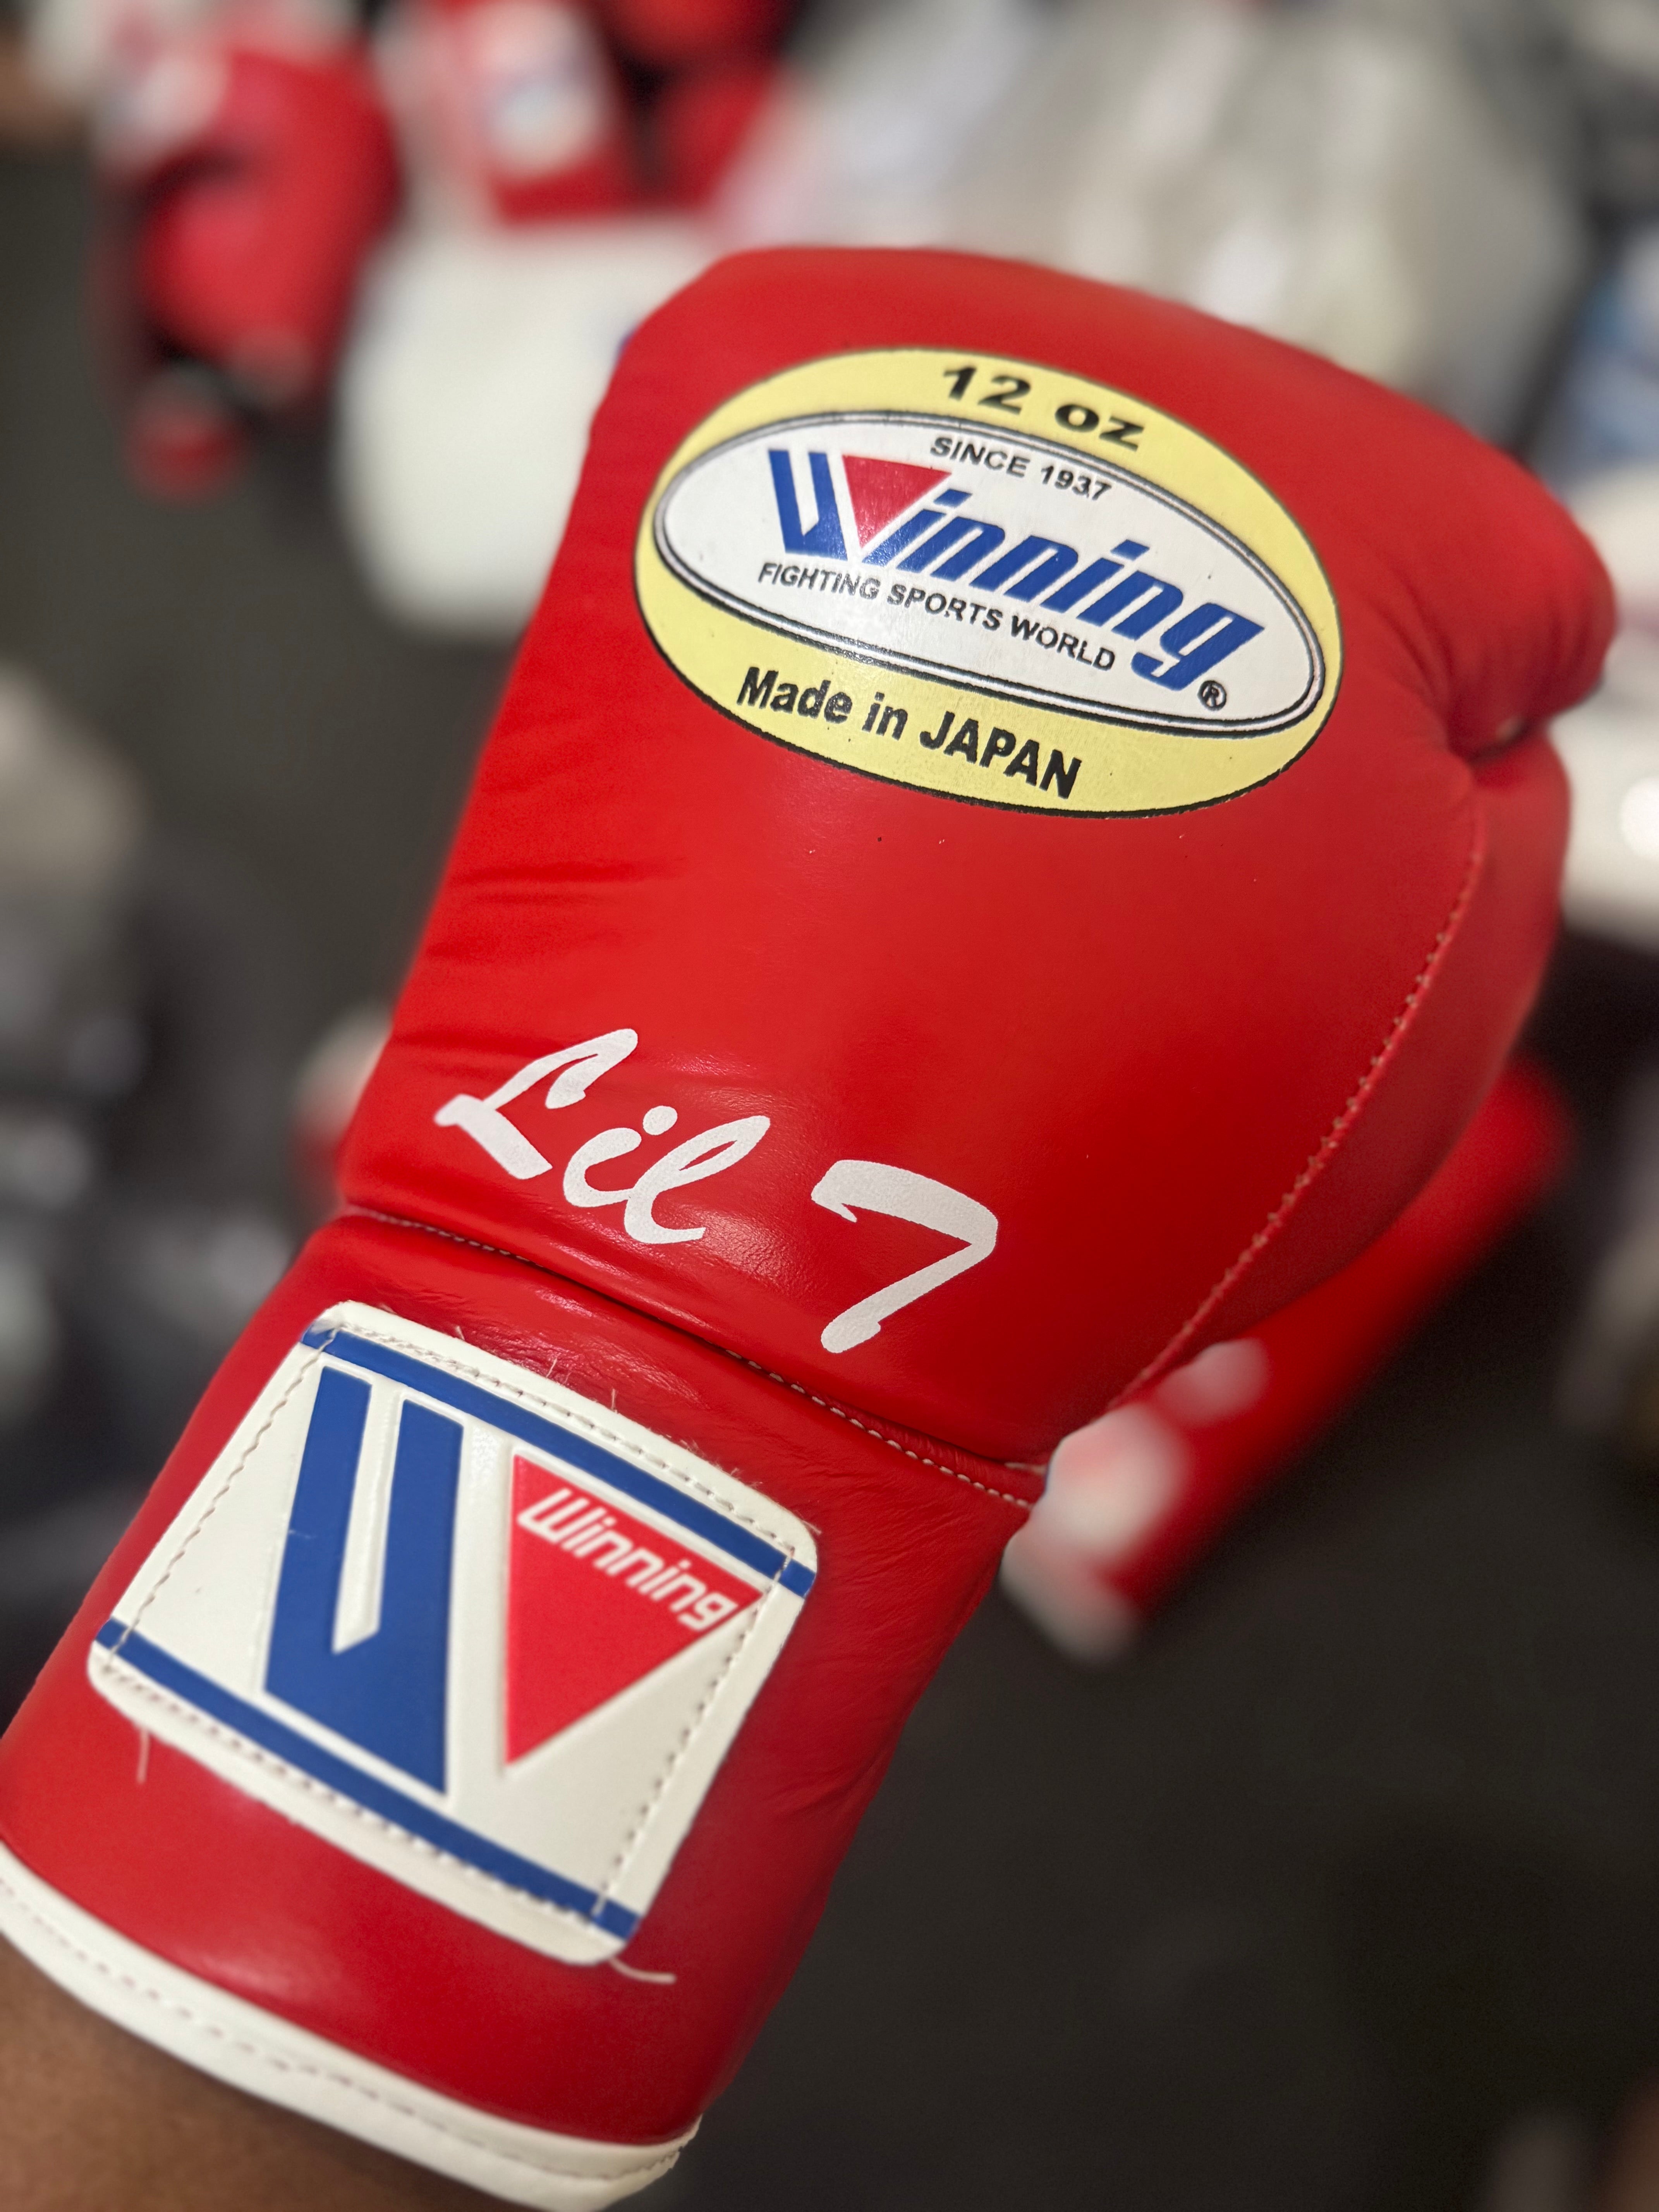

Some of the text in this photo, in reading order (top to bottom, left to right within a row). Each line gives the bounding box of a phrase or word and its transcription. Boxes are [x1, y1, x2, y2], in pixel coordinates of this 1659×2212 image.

[930, 436, 1112, 502] SINCE 1937
[941, 364, 1147, 452] 12 oz
[758, 561, 1116, 672] FIGHTING SPORTS WORLD
[767, 448, 1264, 691] Winning
[737, 666, 1082, 799] Made in JAPAN
[434, 1027, 771, 1245] Lil
[516, 1486, 739, 1632] Winning
